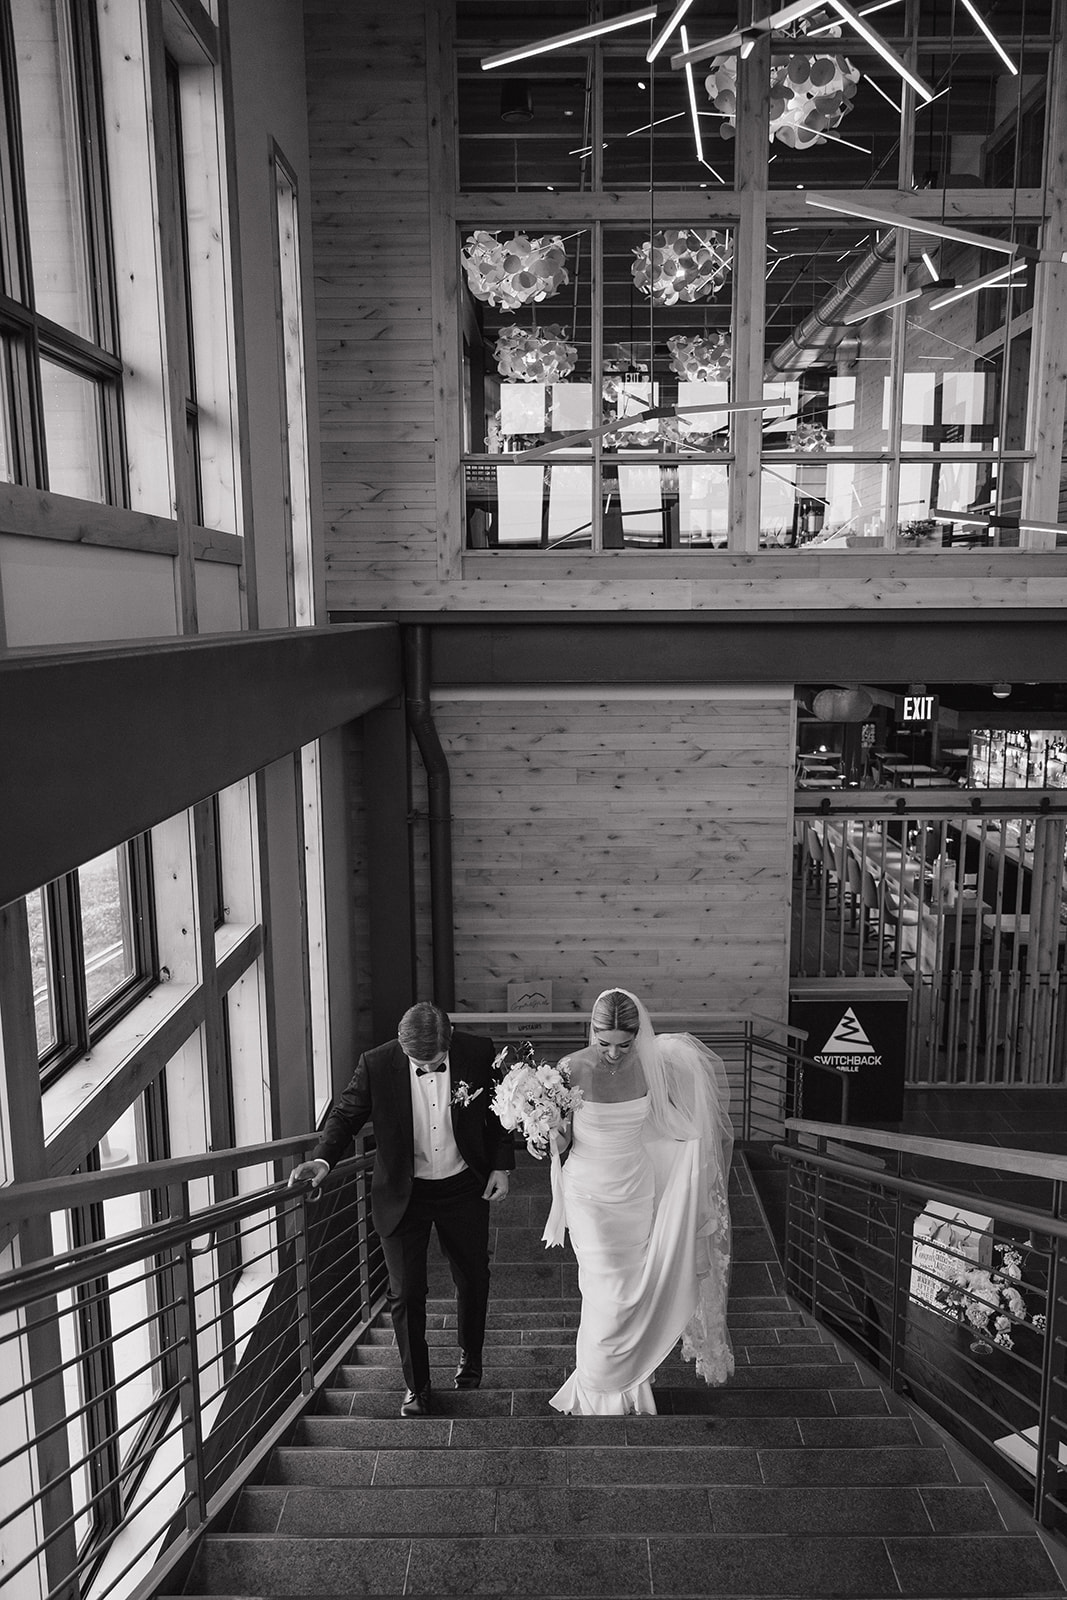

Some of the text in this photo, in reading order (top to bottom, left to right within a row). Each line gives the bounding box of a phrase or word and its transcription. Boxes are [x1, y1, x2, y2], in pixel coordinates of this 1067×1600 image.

[625, 372, 640, 383] EXIT
[903, 696, 935, 720] EXIT
[813, 1055, 882, 1066] SWITCHBACK
